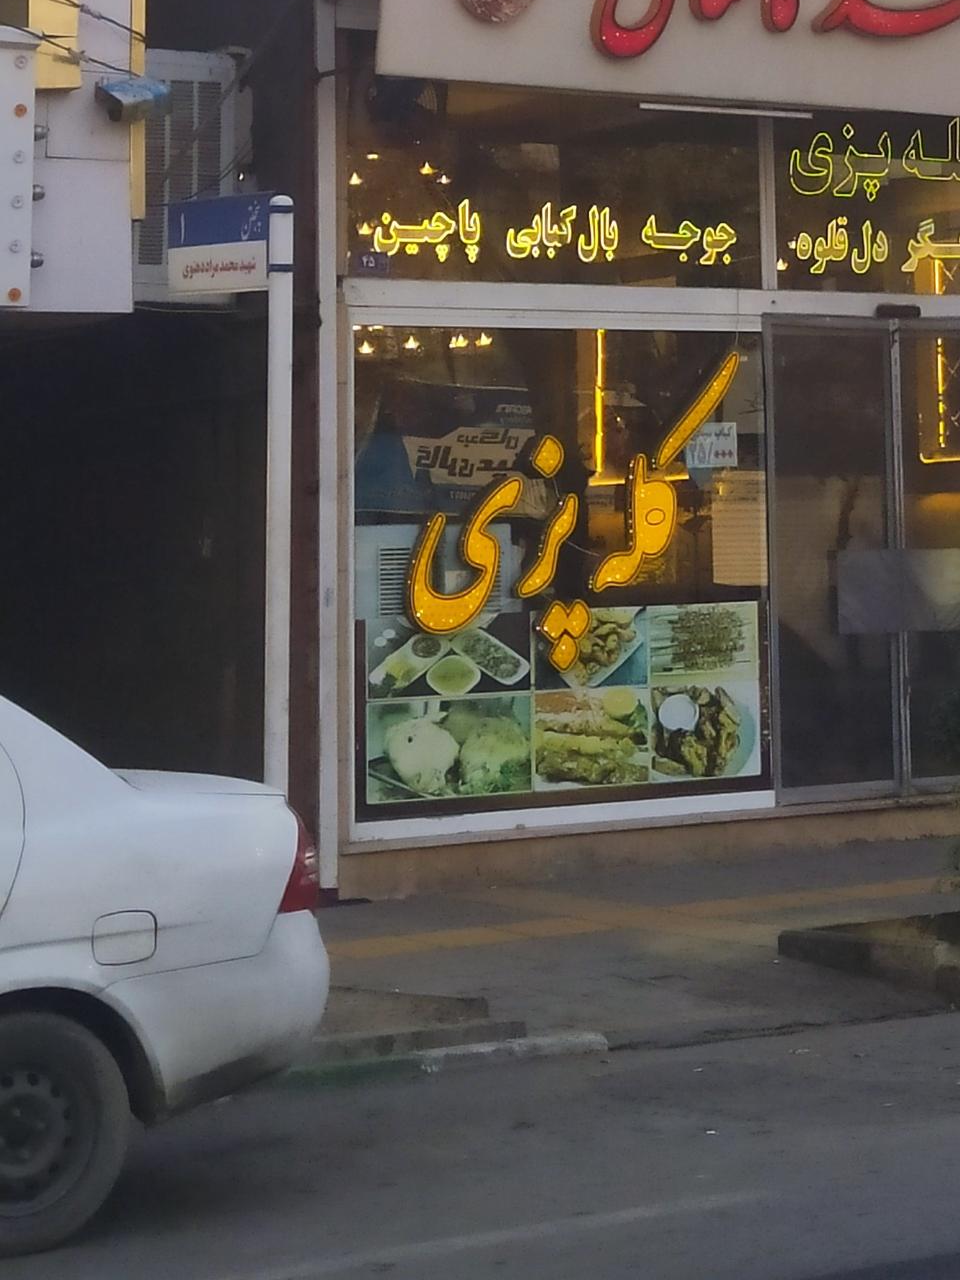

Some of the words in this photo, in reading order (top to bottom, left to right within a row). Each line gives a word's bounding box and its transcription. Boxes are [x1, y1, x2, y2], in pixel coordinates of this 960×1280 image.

[789, 123, 892, 202] پزی
[373, 198, 482, 263] پاچین
[506, 201, 578, 259] کبابی
[577, 204, 620, 264] بال
[641, 214, 738, 265] جوجه
[795, 215, 849, 274] قلوه
[851, 219, 889, 274] دل
[408, 435, 593, 673] پزی
